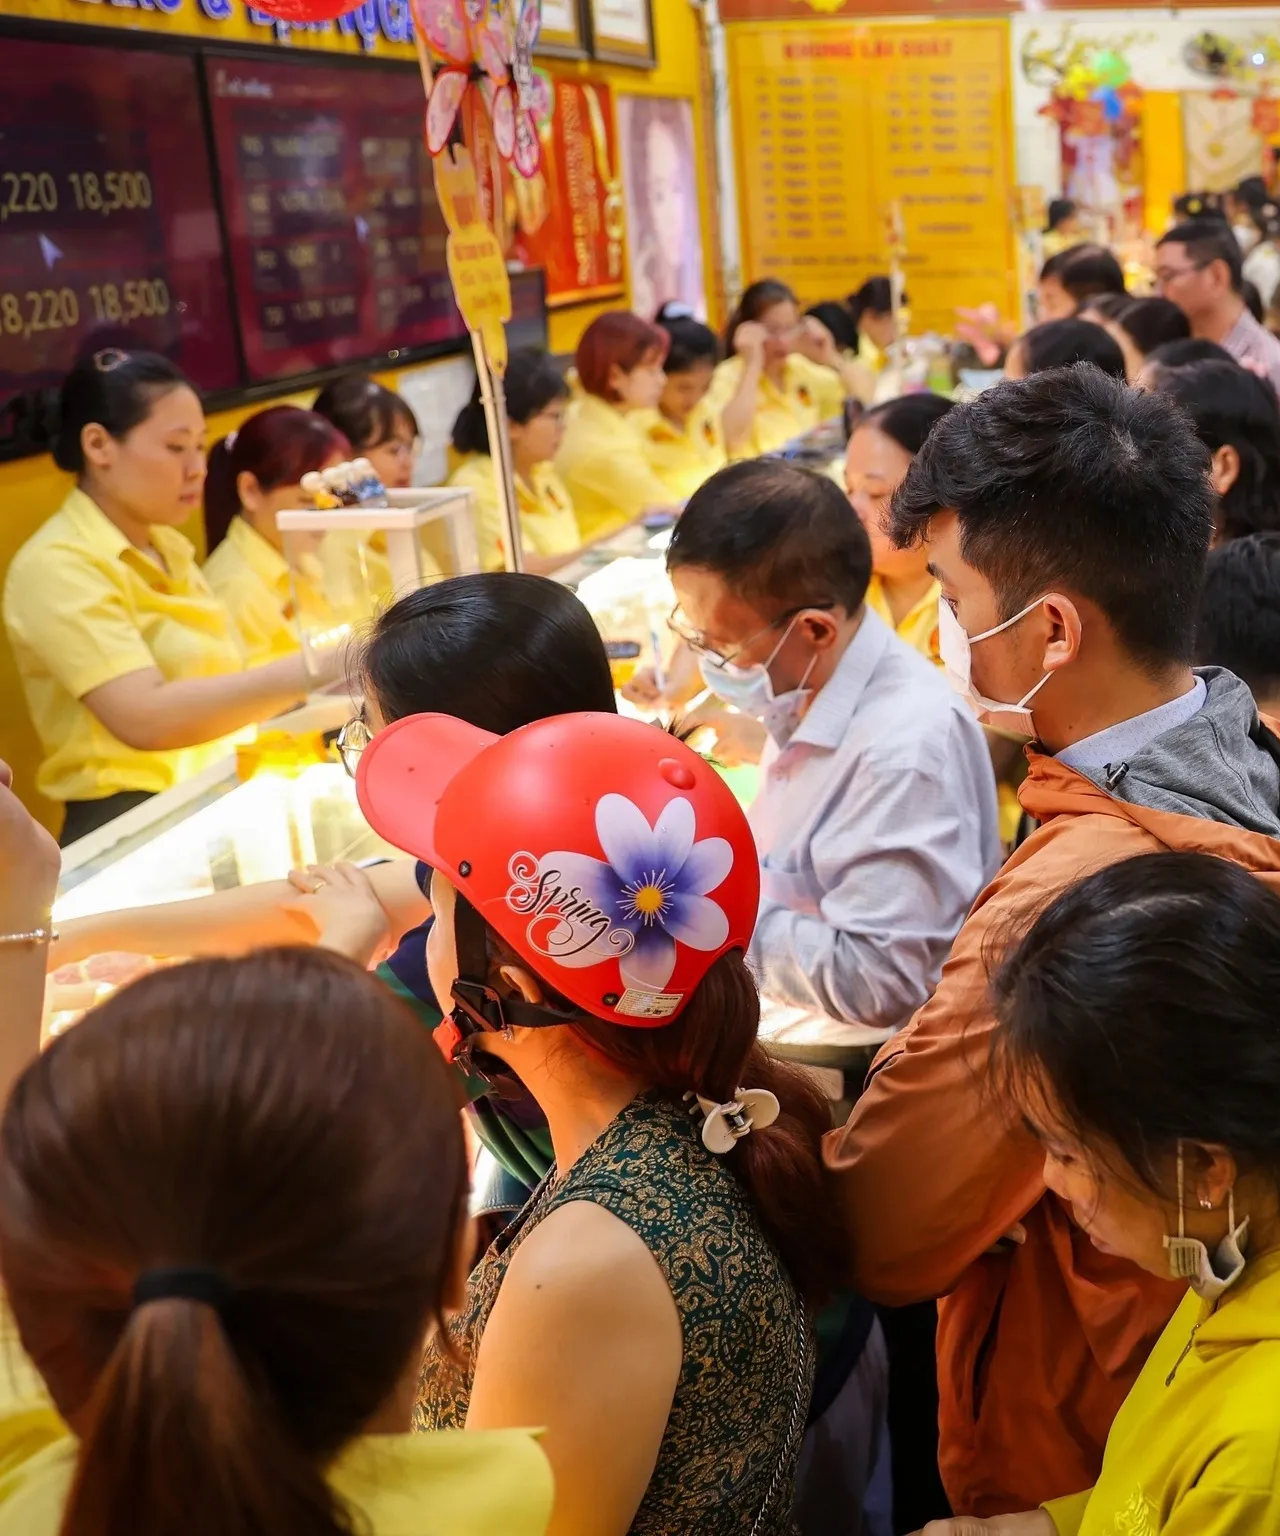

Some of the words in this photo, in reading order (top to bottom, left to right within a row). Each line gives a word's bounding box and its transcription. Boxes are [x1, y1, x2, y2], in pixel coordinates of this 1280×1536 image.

[68, 171, 152, 216] 18,500
[0, 287, 79, 339] 8,220
[89, 278, 170, 325] 18,500
[506, 851, 635, 957] Spring
